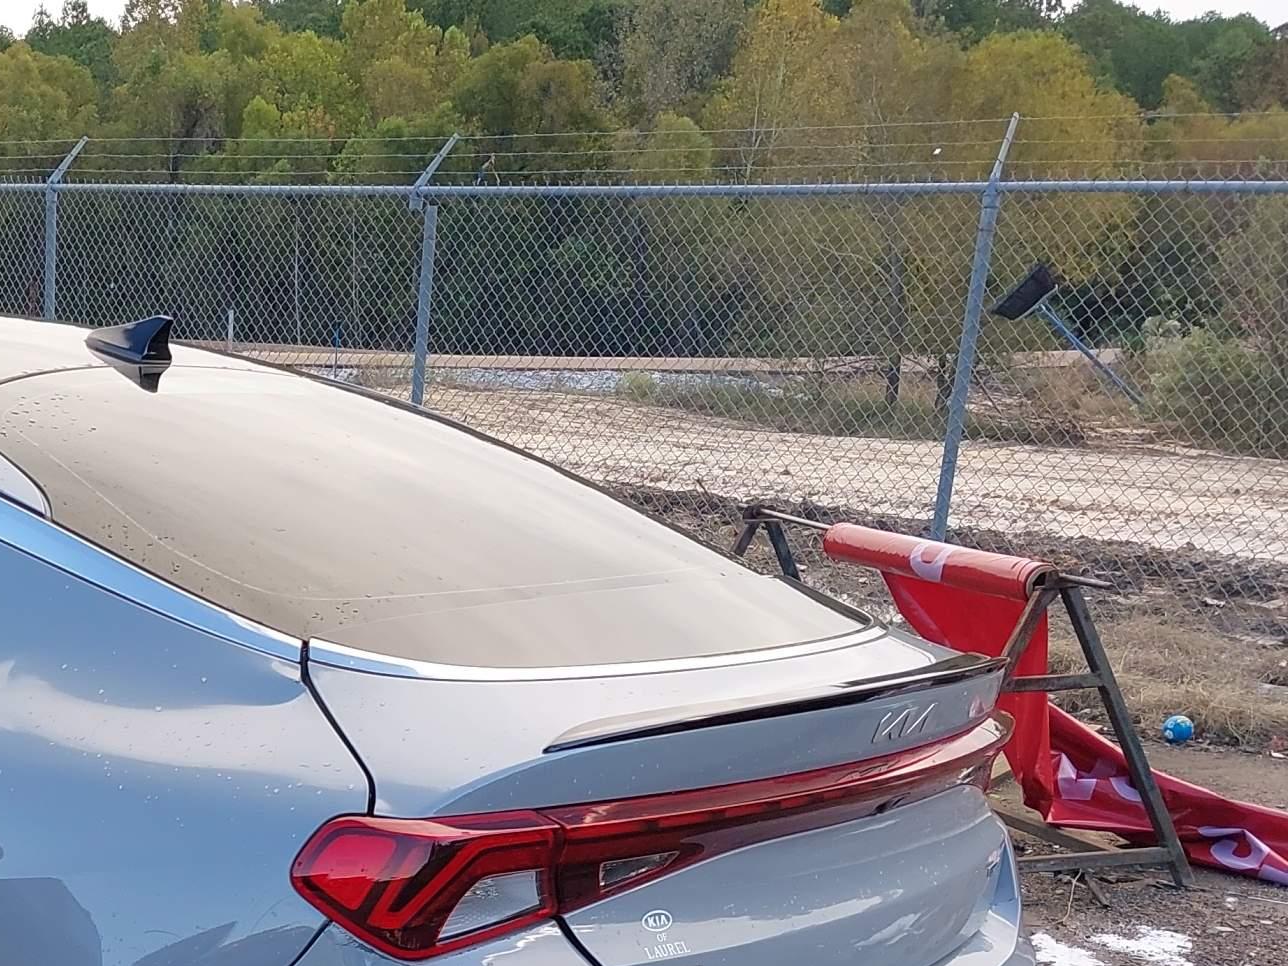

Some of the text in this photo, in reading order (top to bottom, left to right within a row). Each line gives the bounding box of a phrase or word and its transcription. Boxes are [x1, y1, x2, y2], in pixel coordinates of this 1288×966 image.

[871, 702, 938, 743] KIA
[647, 914, 669, 928] KIA
[656, 932, 667, 942] OF
[644, 941, 691, 959] LAUREL
